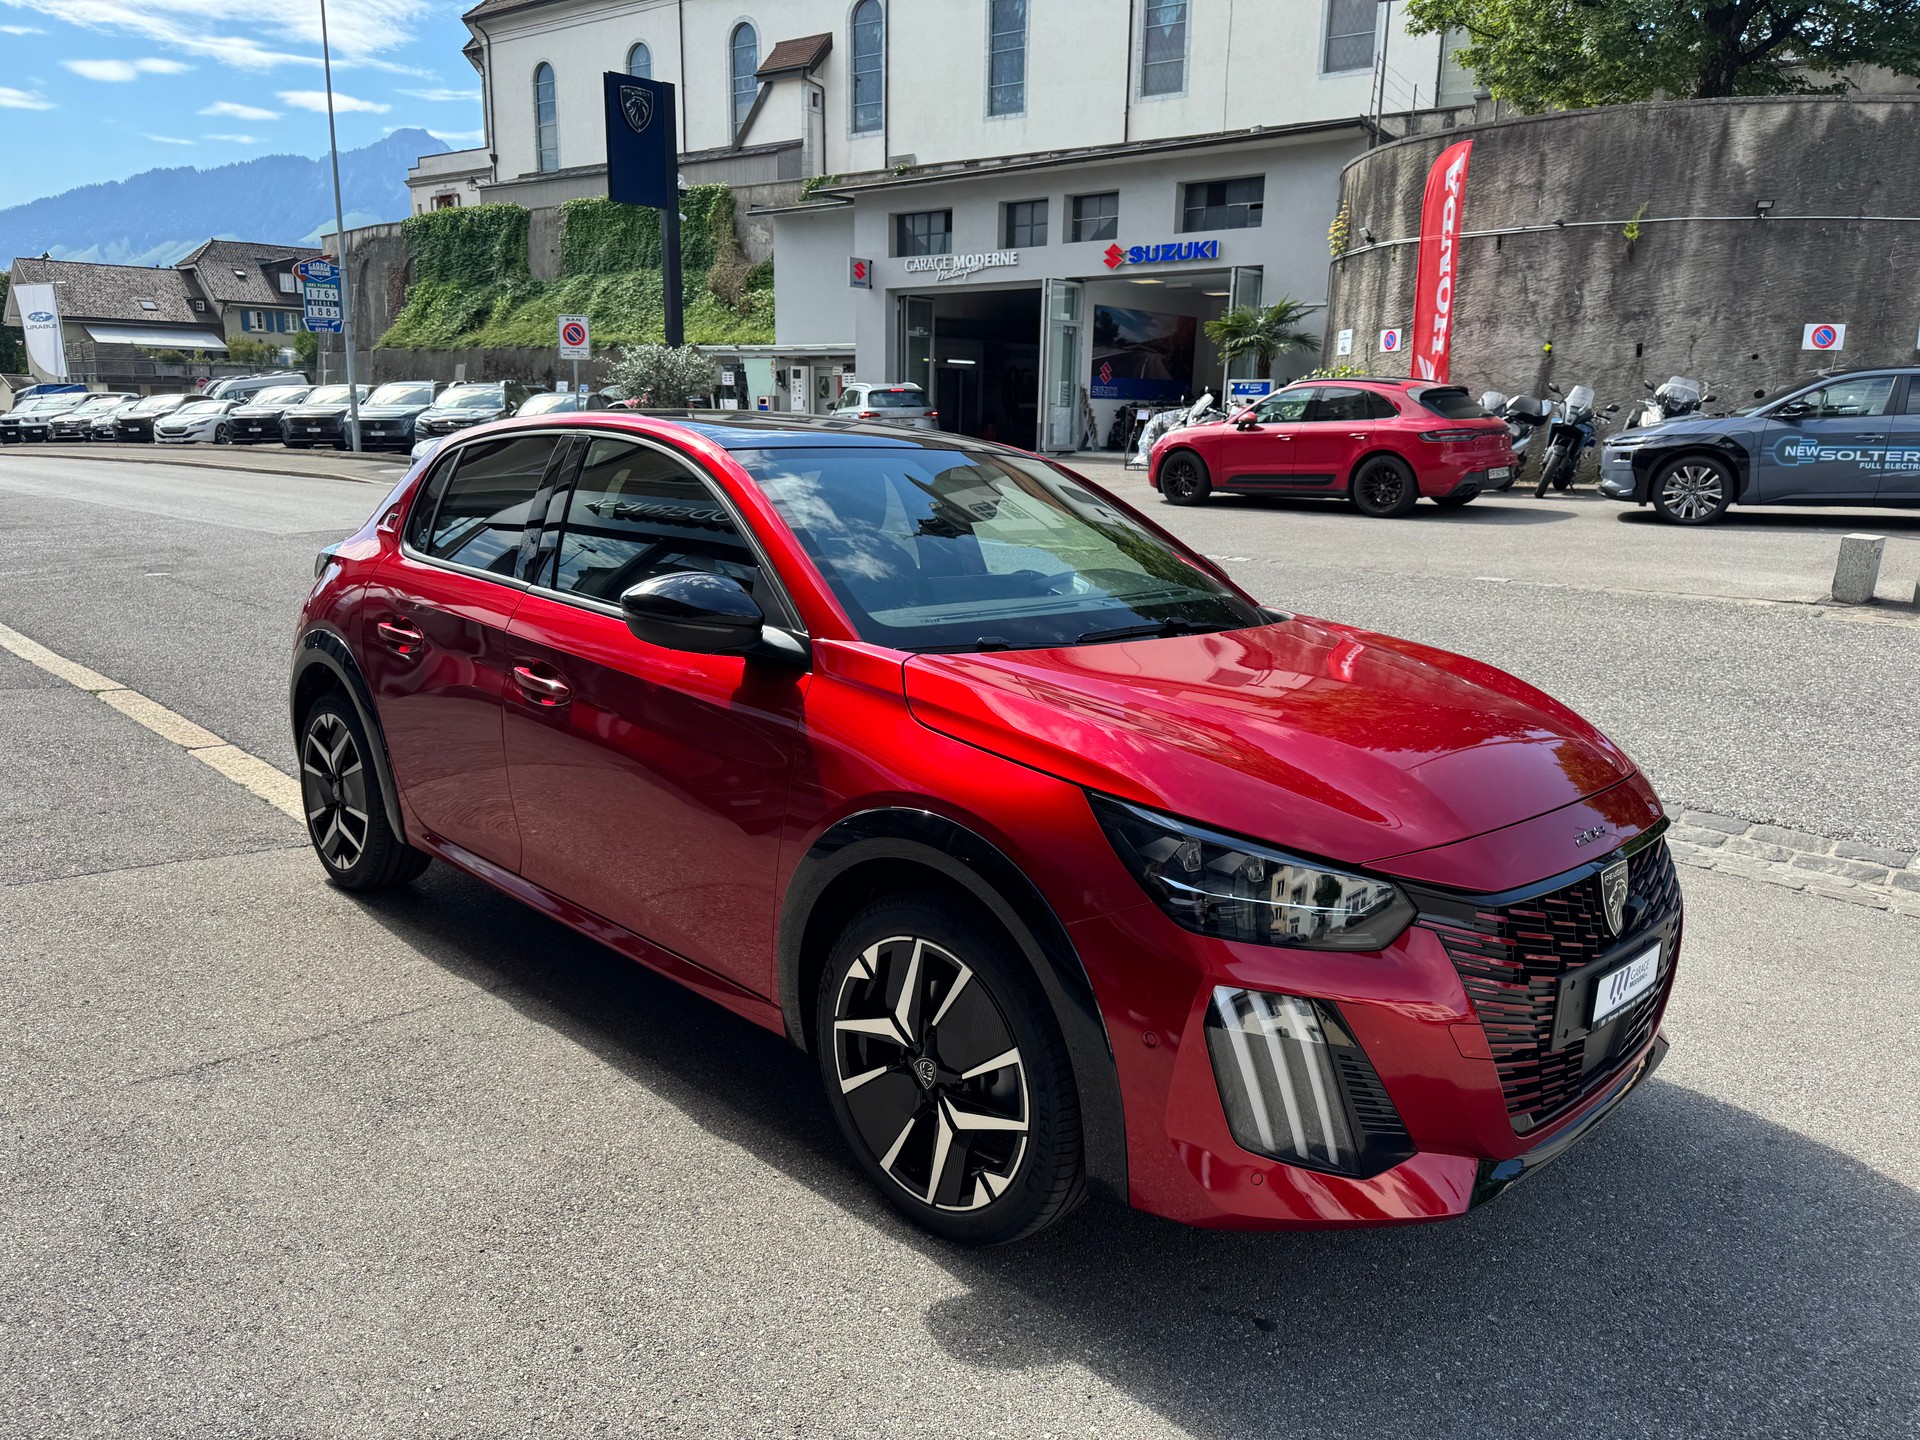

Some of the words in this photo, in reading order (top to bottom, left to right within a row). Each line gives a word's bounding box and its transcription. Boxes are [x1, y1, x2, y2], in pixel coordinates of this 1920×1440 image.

[623, 88, 650, 97] PEUGEOT
[1128, 240, 1219, 264] SUZUKI
[1432, 152, 1465, 355] HONDA
[308, 262, 330, 270] GARAGE
[904, 256, 950, 272] GARAGE
[953, 251, 1018, 269] MODERNE
[1092, 386, 1118, 397] SUZUKI
[1784, 446, 1820, 456] NEW
[1818, 450, 1920, 461] SOLTER
[1885, 462, 1920, 470] ELECTR
[1574, 826, 1606, 848] 208
[1604, 865, 1626, 881] PEUGEOT
[1630, 959, 1650, 980] GARAGE
